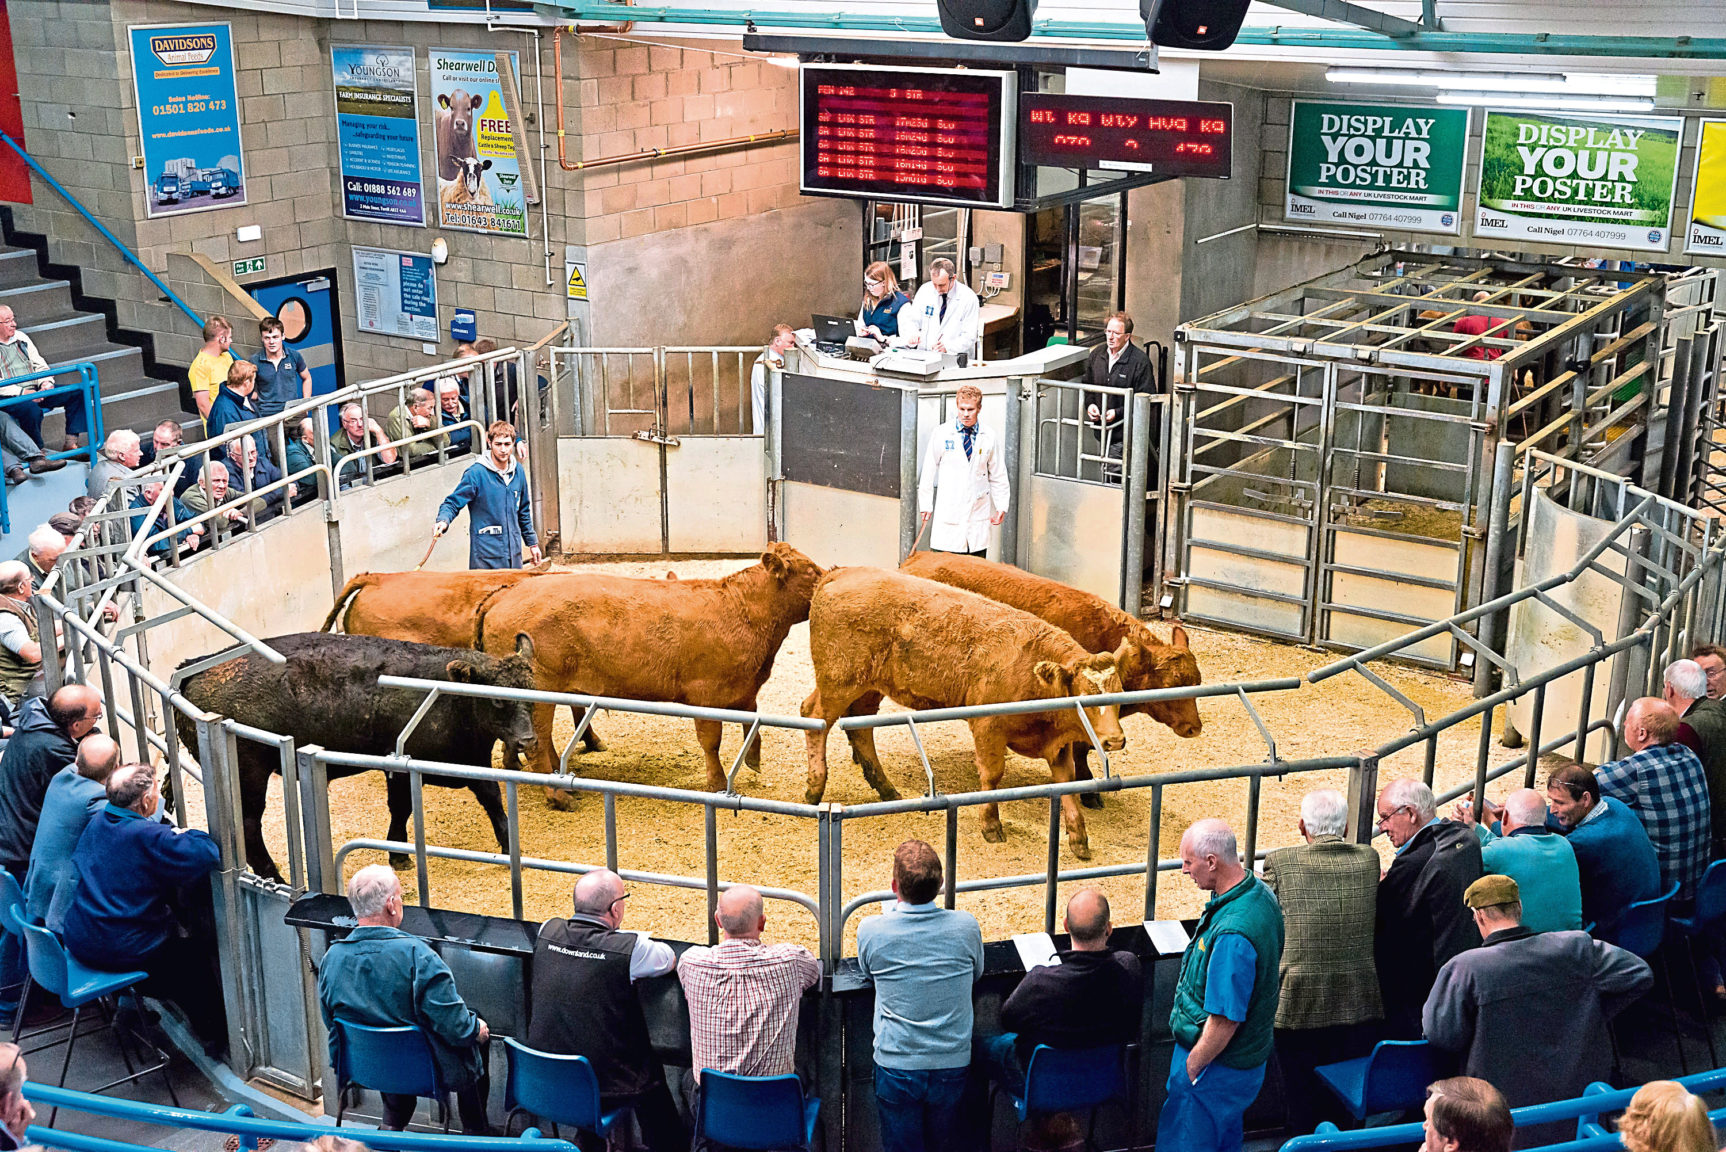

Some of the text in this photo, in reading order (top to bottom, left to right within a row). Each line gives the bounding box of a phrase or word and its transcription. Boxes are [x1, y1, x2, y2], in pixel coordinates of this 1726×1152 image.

[155, 37, 213, 51] DAVIDSONS
[168, 52, 203, 61] Animal Feeds
[348, 63, 400, 77] YOUNGSON
[437, 58, 498, 72] Shearwell D
[339, 91, 352, 99] FARM
[152, 100, 226, 115] 01501 820 473
[342, 120, 365, 129] Managing
[480, 119, 511, 133] FREE
[1320, 114, 1435, 138] DISPLAY
[399, 134, 413, 142] future
[1517, 123, 1645, 150] DISPLAY
[1321, 135, 1431, 168] YOUR
[1517, 145, 1639, 182] YOUR
[1318, 163, 1428, 189] POSTER
[347, 181, 416, 197] Call: 01888 562 689
[1513, 175, 1634, 204] POSTER
[445, 202, 520, 216] www.shearwell.co.uk
[1291, 204, 1315, 213] IMEL
[1573, 207, 1611, 215] LIVESTOCK
[446, 213, 520, 230] Tel: 01643 841611
[1348, 212, 1366, 220] Nigel
[1369, 212, 1392, 221] 07764
[1393, 214, 1421, 224] 407999
[1481, 218, 1508, 228] IMEL
[1527, 225, 1626, 240] Call Nigel 07764 407999
[1692, 235, 1723, 245] IMEL
[547, 944, 606, 960] www.downland.co.uk
